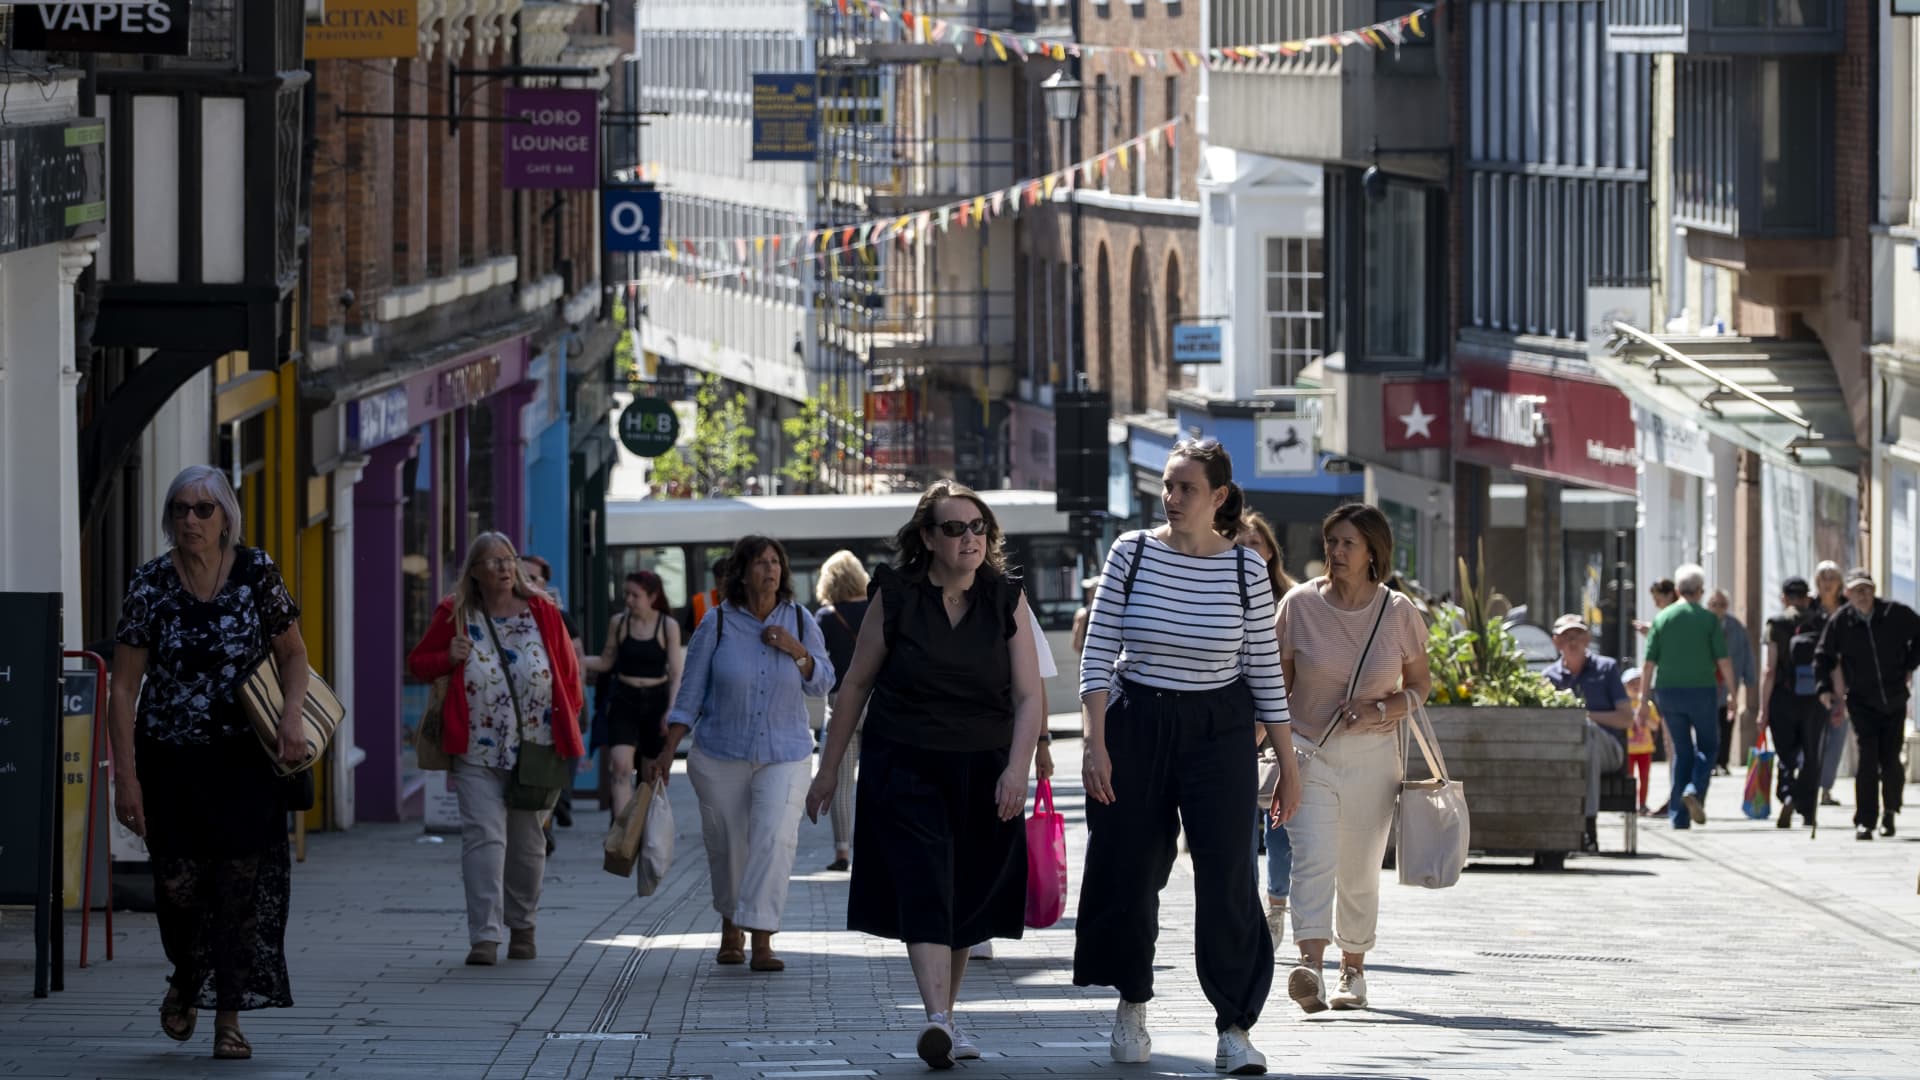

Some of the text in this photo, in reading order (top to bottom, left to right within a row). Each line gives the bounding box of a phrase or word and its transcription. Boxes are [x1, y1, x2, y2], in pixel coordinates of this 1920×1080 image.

[38, 3, 171, 34] VAPES
[324, 8, 409, 27] CITANE
[317, 31, 384, 41] PROVENCE
[512, 135, 589, 152] LOUNGE
[555, 164, 574, 174] BAR
[64, 751, 81, 762] es
